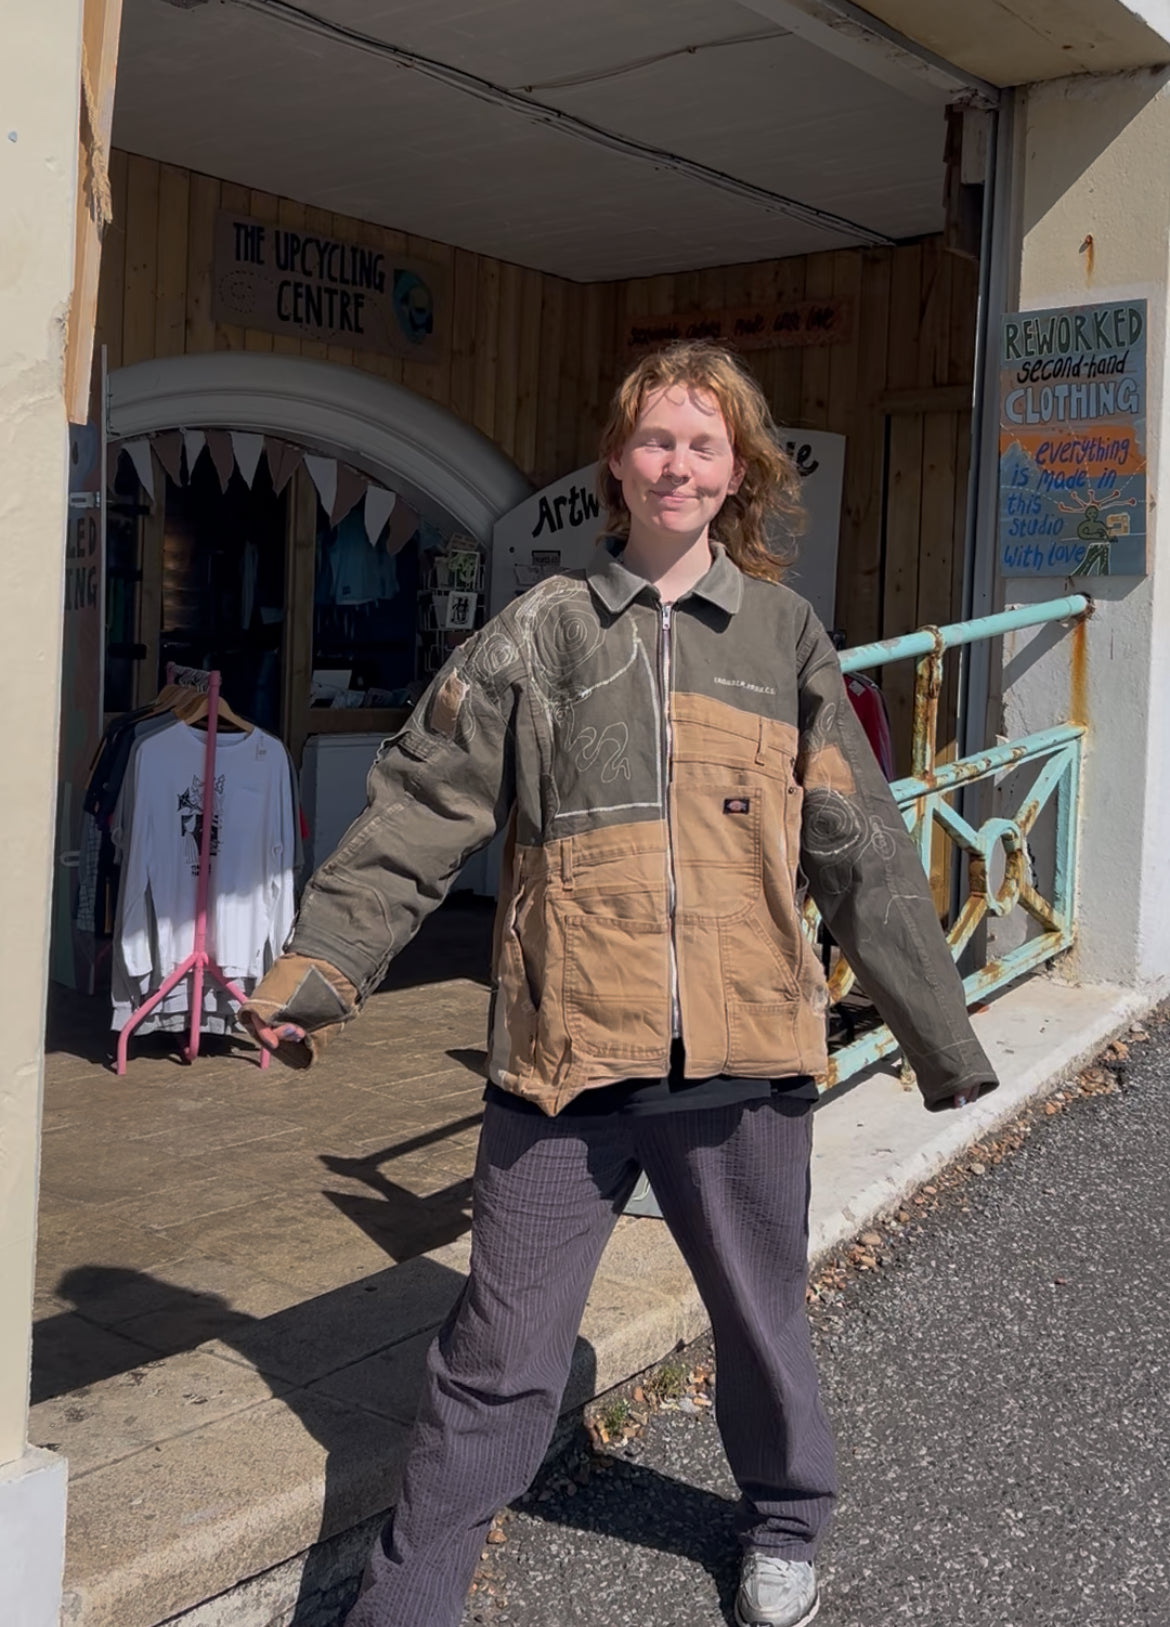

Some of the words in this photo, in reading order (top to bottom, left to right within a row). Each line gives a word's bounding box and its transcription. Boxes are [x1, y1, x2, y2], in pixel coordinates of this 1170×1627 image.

[233, 222, 266, 266] THE
[274, 230, 386, 294] UPCYCLING
[276, 280, 365, 334] CENTRE
[1005, 307, 1143, 360] REWORKED
[1016, 349, 1130, 384] second-hand
[1004, 377, 1140, 424] CLOTHING
[1035, 437, 1130, 465] everything
[1011, 463, 1030, 487] is
[1096, 466, 1118, 489] in
[1007, 493, 1042, 515] this
[1046, 541, 1087, 567] love
